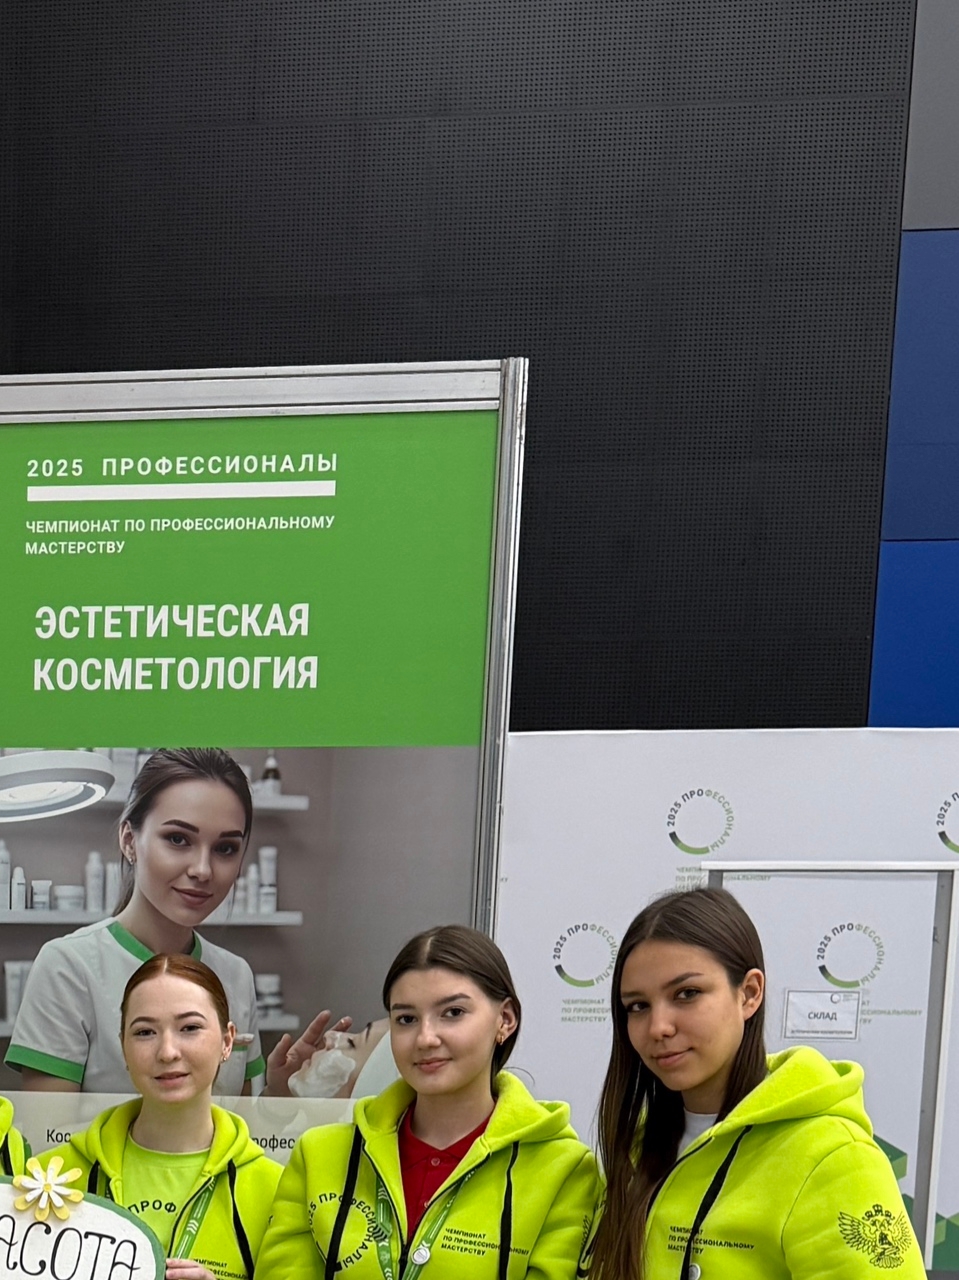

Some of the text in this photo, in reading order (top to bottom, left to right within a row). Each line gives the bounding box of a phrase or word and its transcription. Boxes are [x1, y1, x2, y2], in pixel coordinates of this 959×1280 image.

[27, 453, 338, 477] 2025 ПРОФЕССИОНАЛЫ
[25, 515, 336, 534] ЧЕМПИОНАТ ПО ПРОФЕССИОНАЛЬНОМУ
[25, 541, 126, 555] МАСТЕРСТВУ
[34, 603, 310, 639] ЭСТЕТИЧЕСКАЯ
[33, 656, 318, 691] КОСМЕТОЛОГИЯ
[666, 788, 734, 852] 2025 ПРОФЕССИОНАЛЫ
[936, 799, 952, 827] 2025
[552, 934, 568, 960] 2025
[816, 922, 885, 986] 2025 ПРОФЕССИОНАЛЫ
[807, 1011, 838, 1022] СКЛАД
[441, 1243, 486, 1257] МАСТЕРСТВУ
